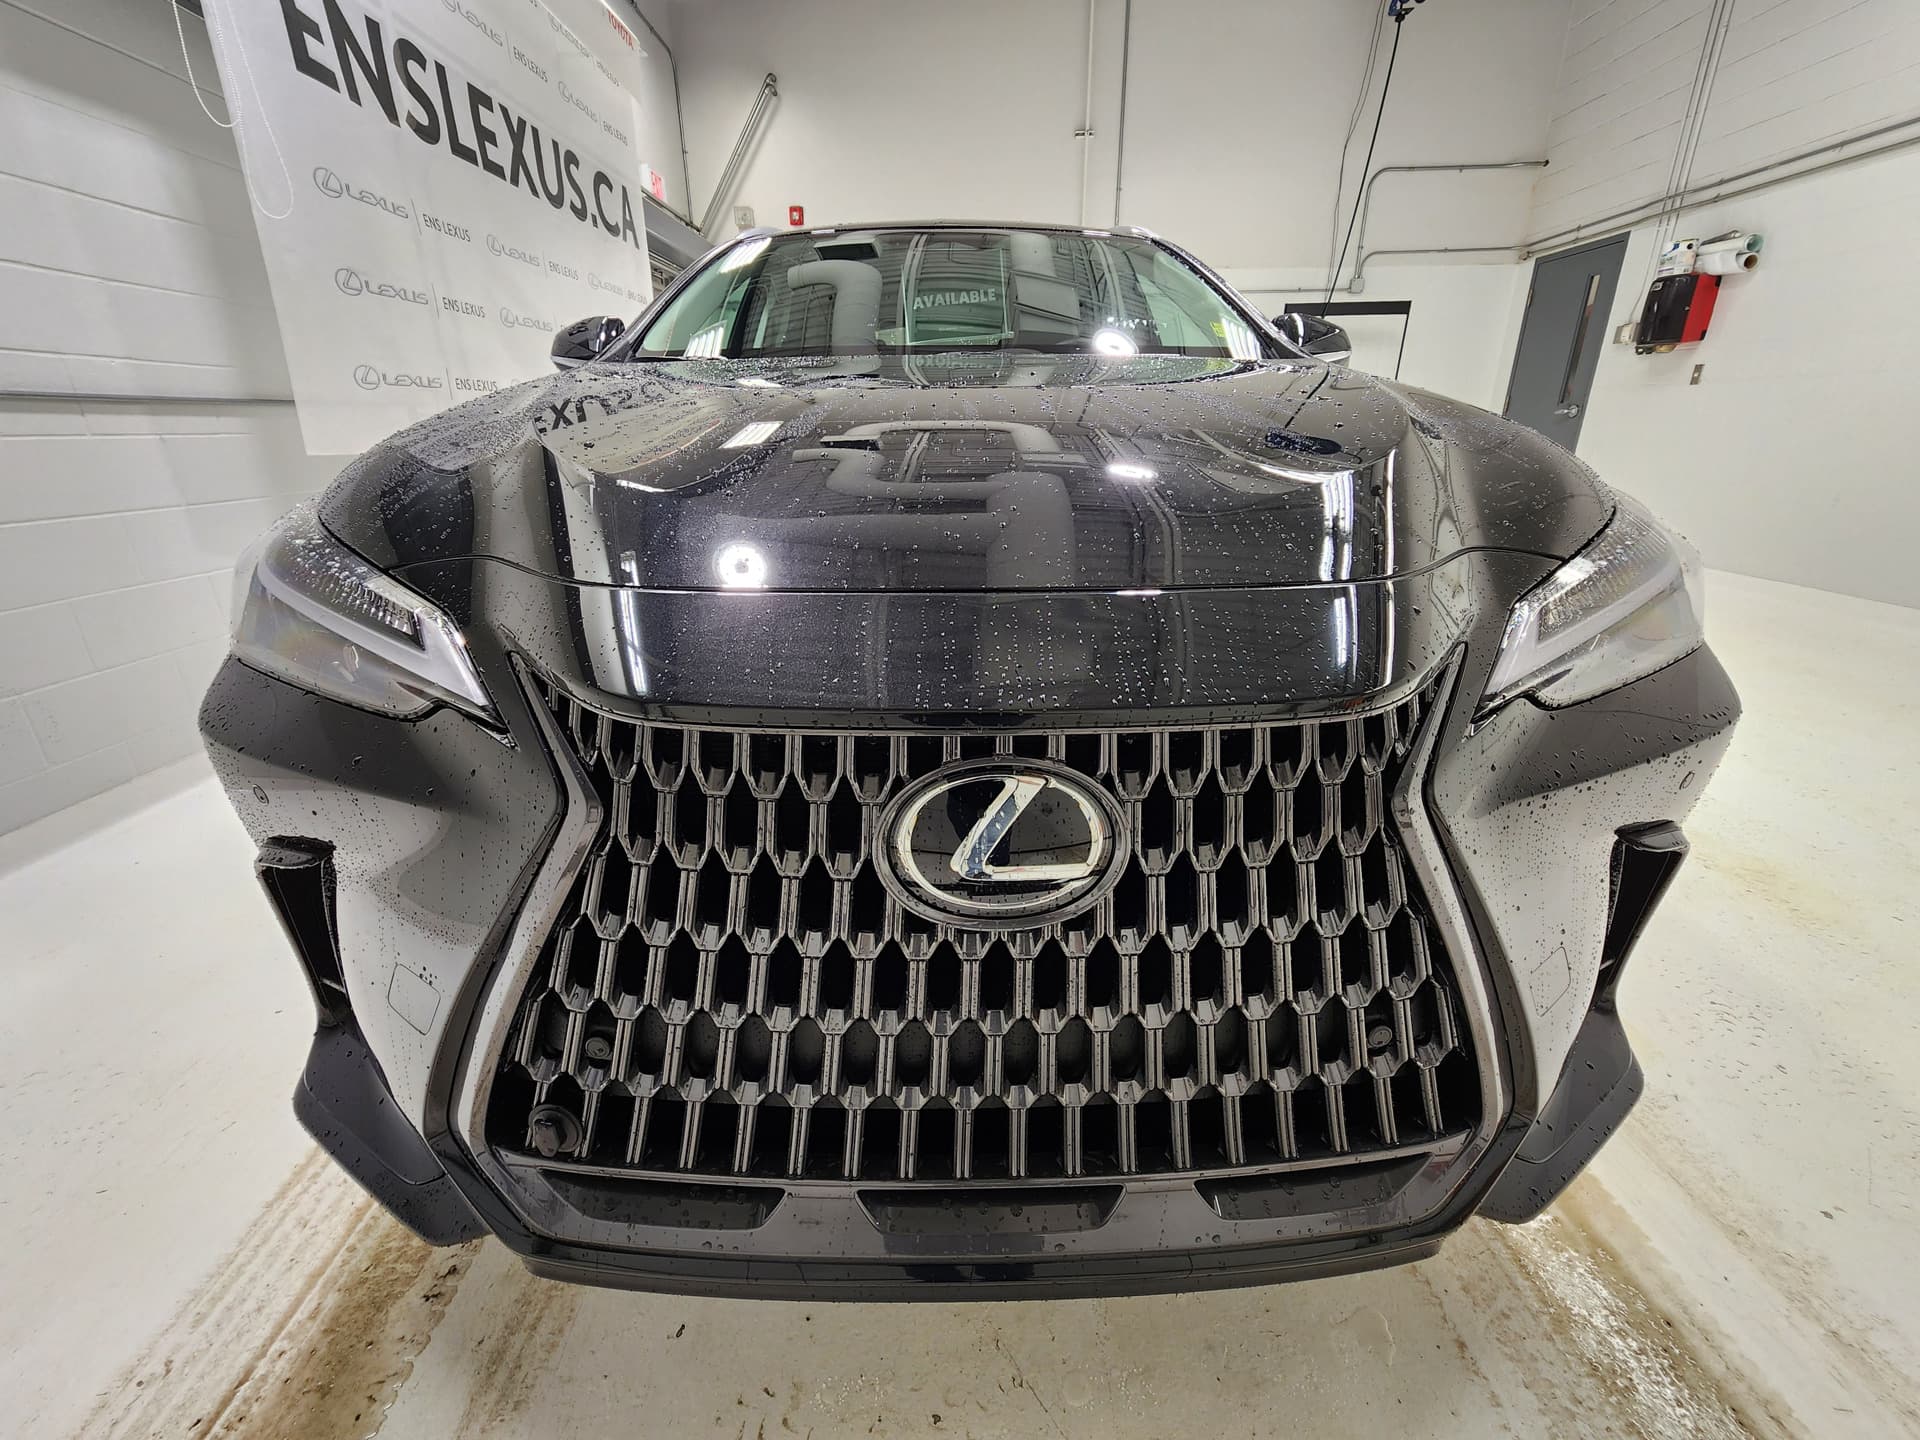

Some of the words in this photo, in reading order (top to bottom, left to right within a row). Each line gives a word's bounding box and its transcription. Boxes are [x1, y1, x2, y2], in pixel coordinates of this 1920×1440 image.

[607, 9, 634, 50] TOYOTA
[280, 0, 640, 249] ENSLEXUS.CA
[345, 183, 409, 219] LEXUS
[422, 212, 442, 233] ENS
[442, 222, 471, 242] LEXUS
[364, 279, 429, 305] LEXUS
[442, 297, 460, 312] ENS
[460, 302, 486, 319] LEXUS
[913, 288, 997, 310] AVAILABLE
[382, 371, 443, 388] LEXUS
[455, 378, 473, 391] ENS
[473, 379, 499, 392] LEXUS
